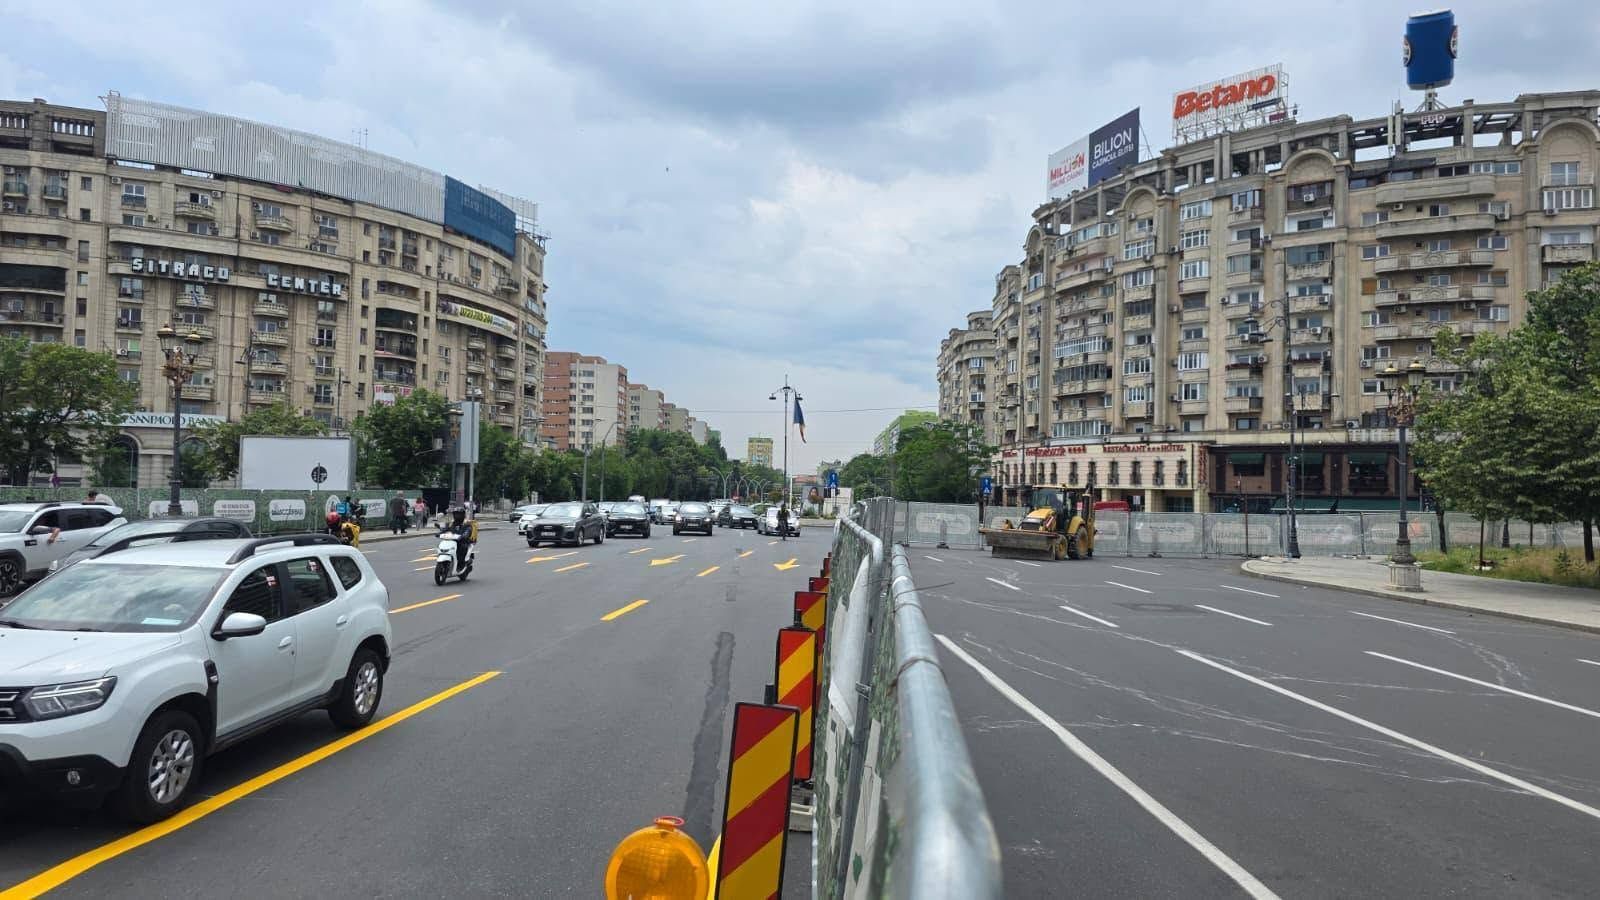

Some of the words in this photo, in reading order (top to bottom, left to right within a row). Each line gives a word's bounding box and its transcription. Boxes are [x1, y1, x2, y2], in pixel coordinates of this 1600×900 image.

[1174, 75, 1275, 119] Betano
[1094, 127, 1132, 160] BILION
[132, 258, 230, 281] SITRACO
[267, 273, 343, 297] CENTER
